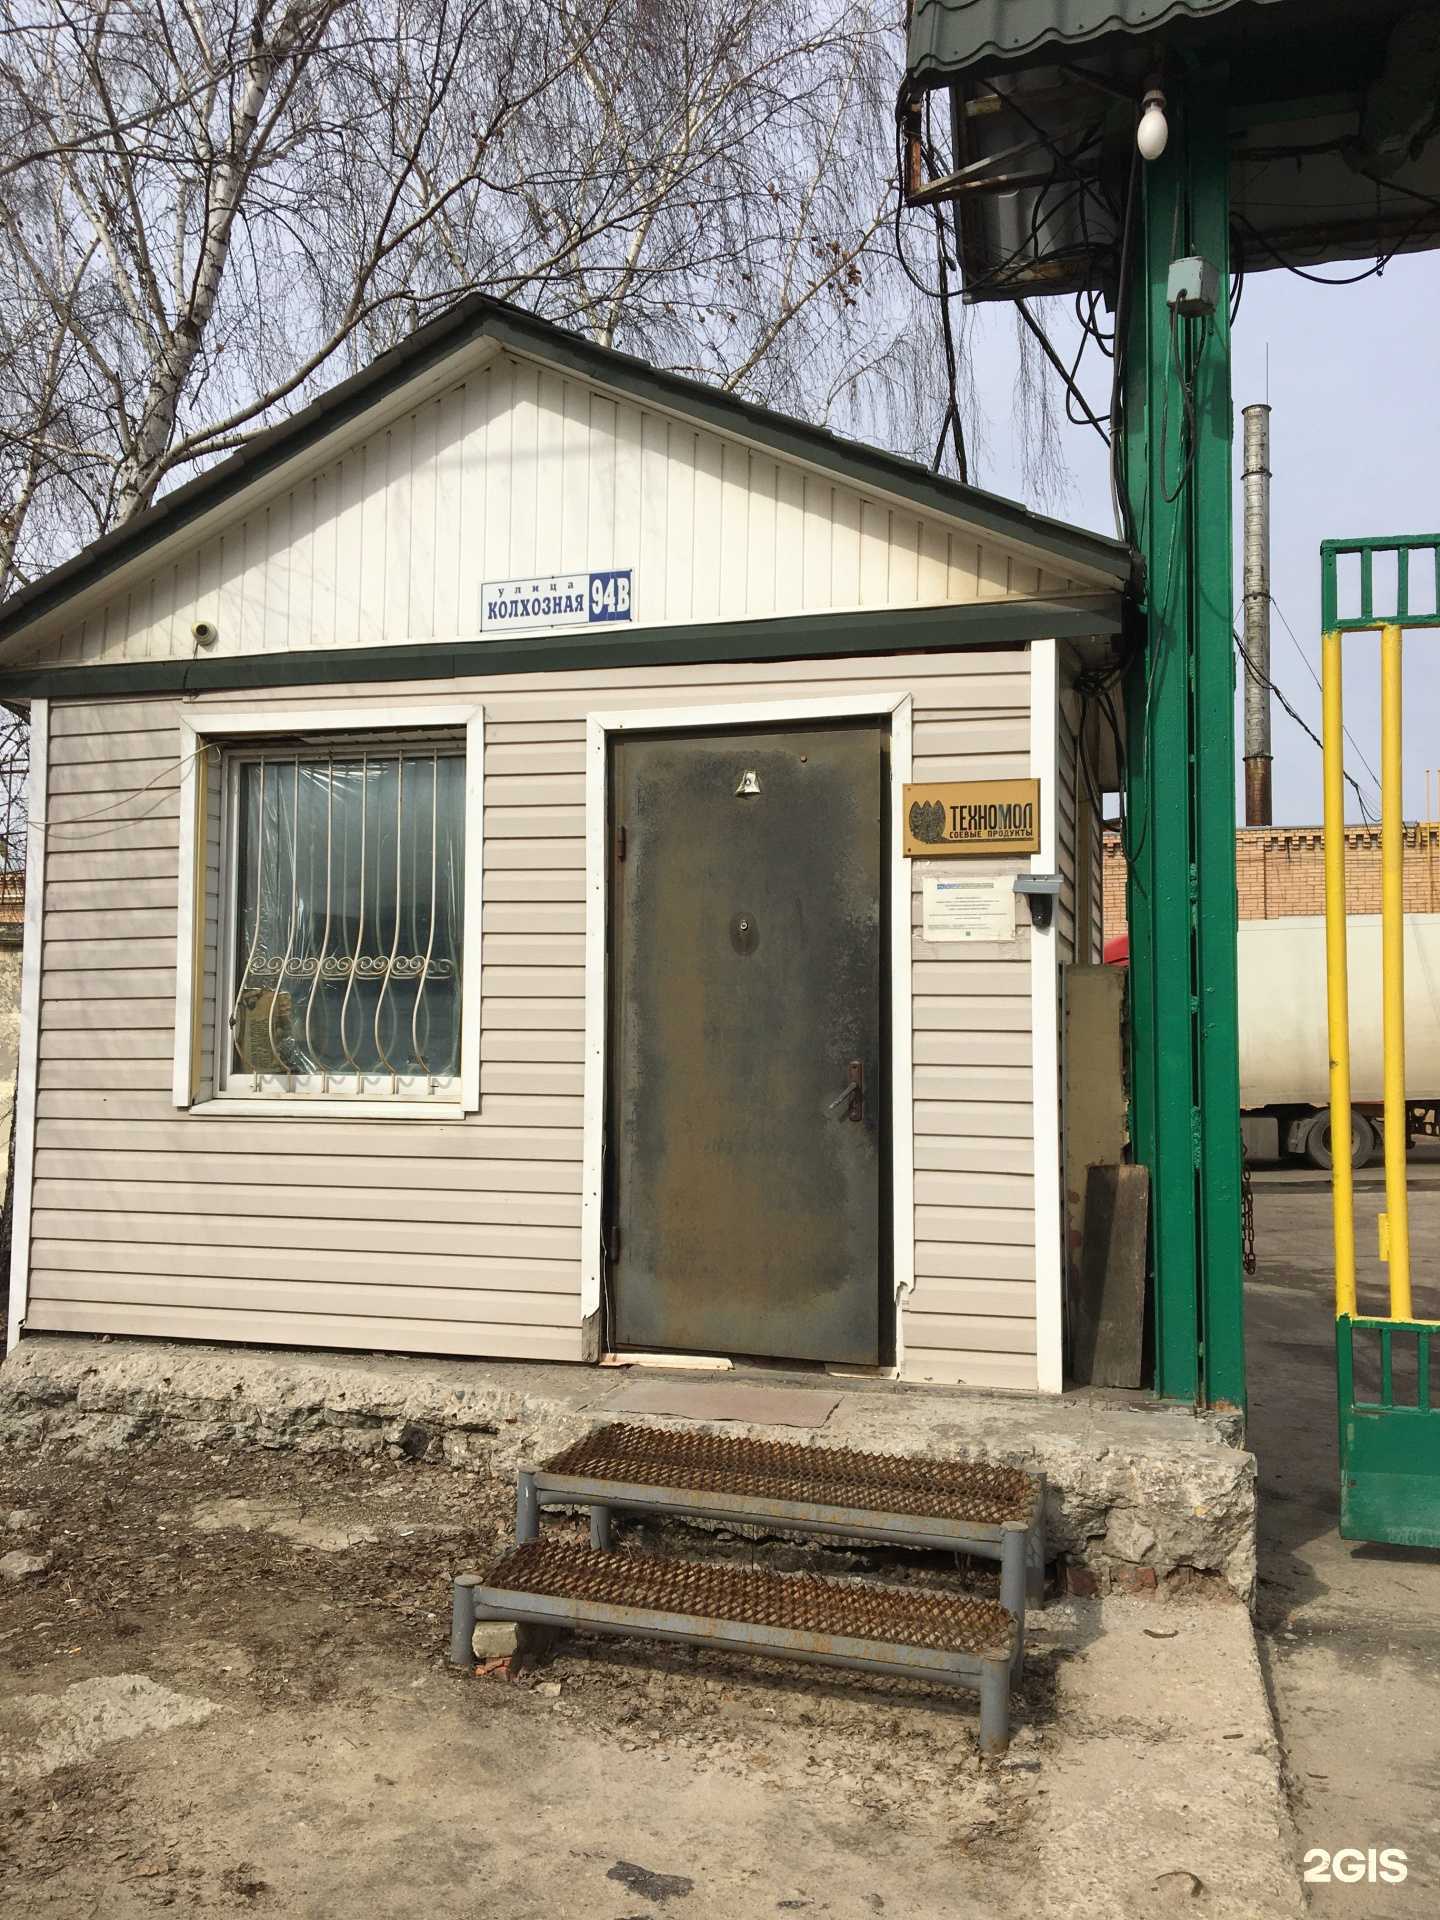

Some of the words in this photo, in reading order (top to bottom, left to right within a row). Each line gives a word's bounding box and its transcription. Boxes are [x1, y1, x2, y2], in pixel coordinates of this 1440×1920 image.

[487, 594, 584, 620] КОЛХОЗНАЯ
[591, 577, 630, 615] 94В
[949, 802, 1033, 831] ТЕХНОМОЛ
[949, 830, 982, 839] СОЕВЫЕ
[987, 827, 1033, 838] ПРОДУКТЫ
